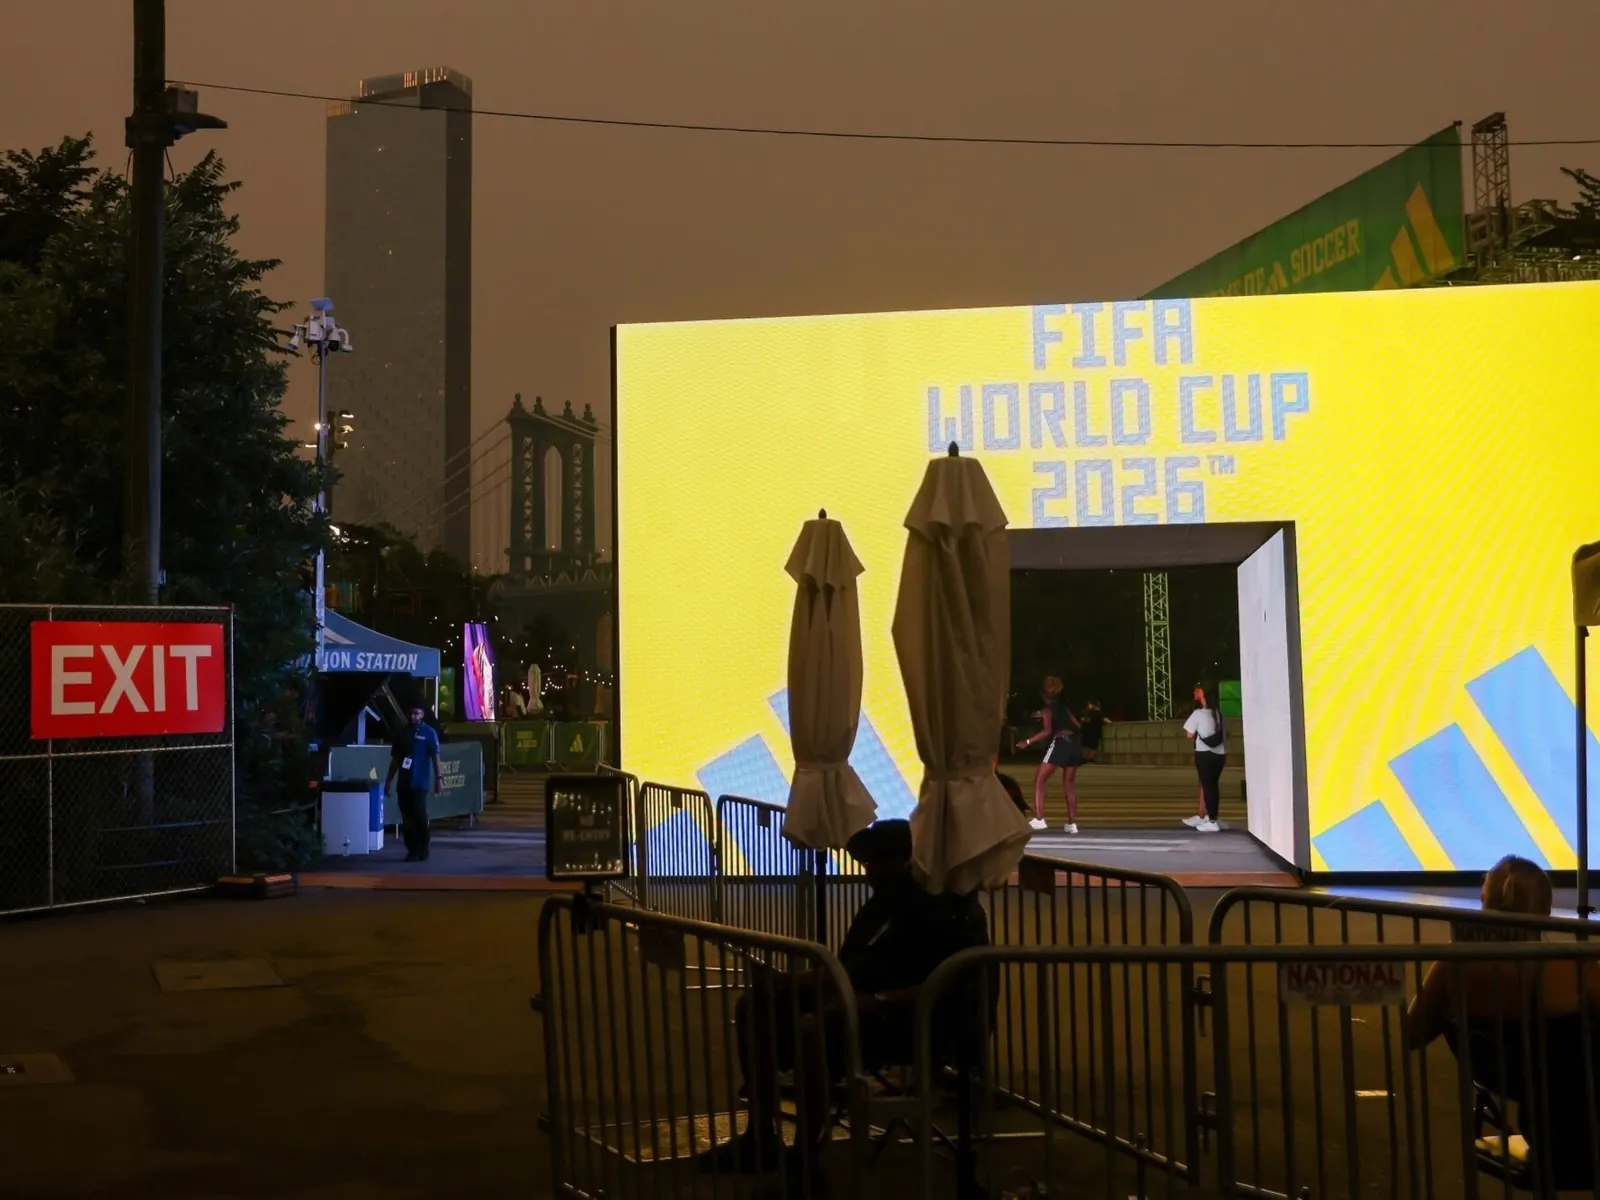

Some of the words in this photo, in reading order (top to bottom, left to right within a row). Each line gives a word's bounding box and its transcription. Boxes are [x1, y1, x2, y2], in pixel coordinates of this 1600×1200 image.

[1290, 219, 1361, 285] SOCCER
[1033, 299, 1193, 369] FIFA
[928, 378, 1151, 451] WORLD
[1180, 372, 1310, 443] CUP
[50, 644, 212, 716] EXIT
[356, 652, 418, 671] STATION
[1287, 963, 1401, 987] NATIONAL
